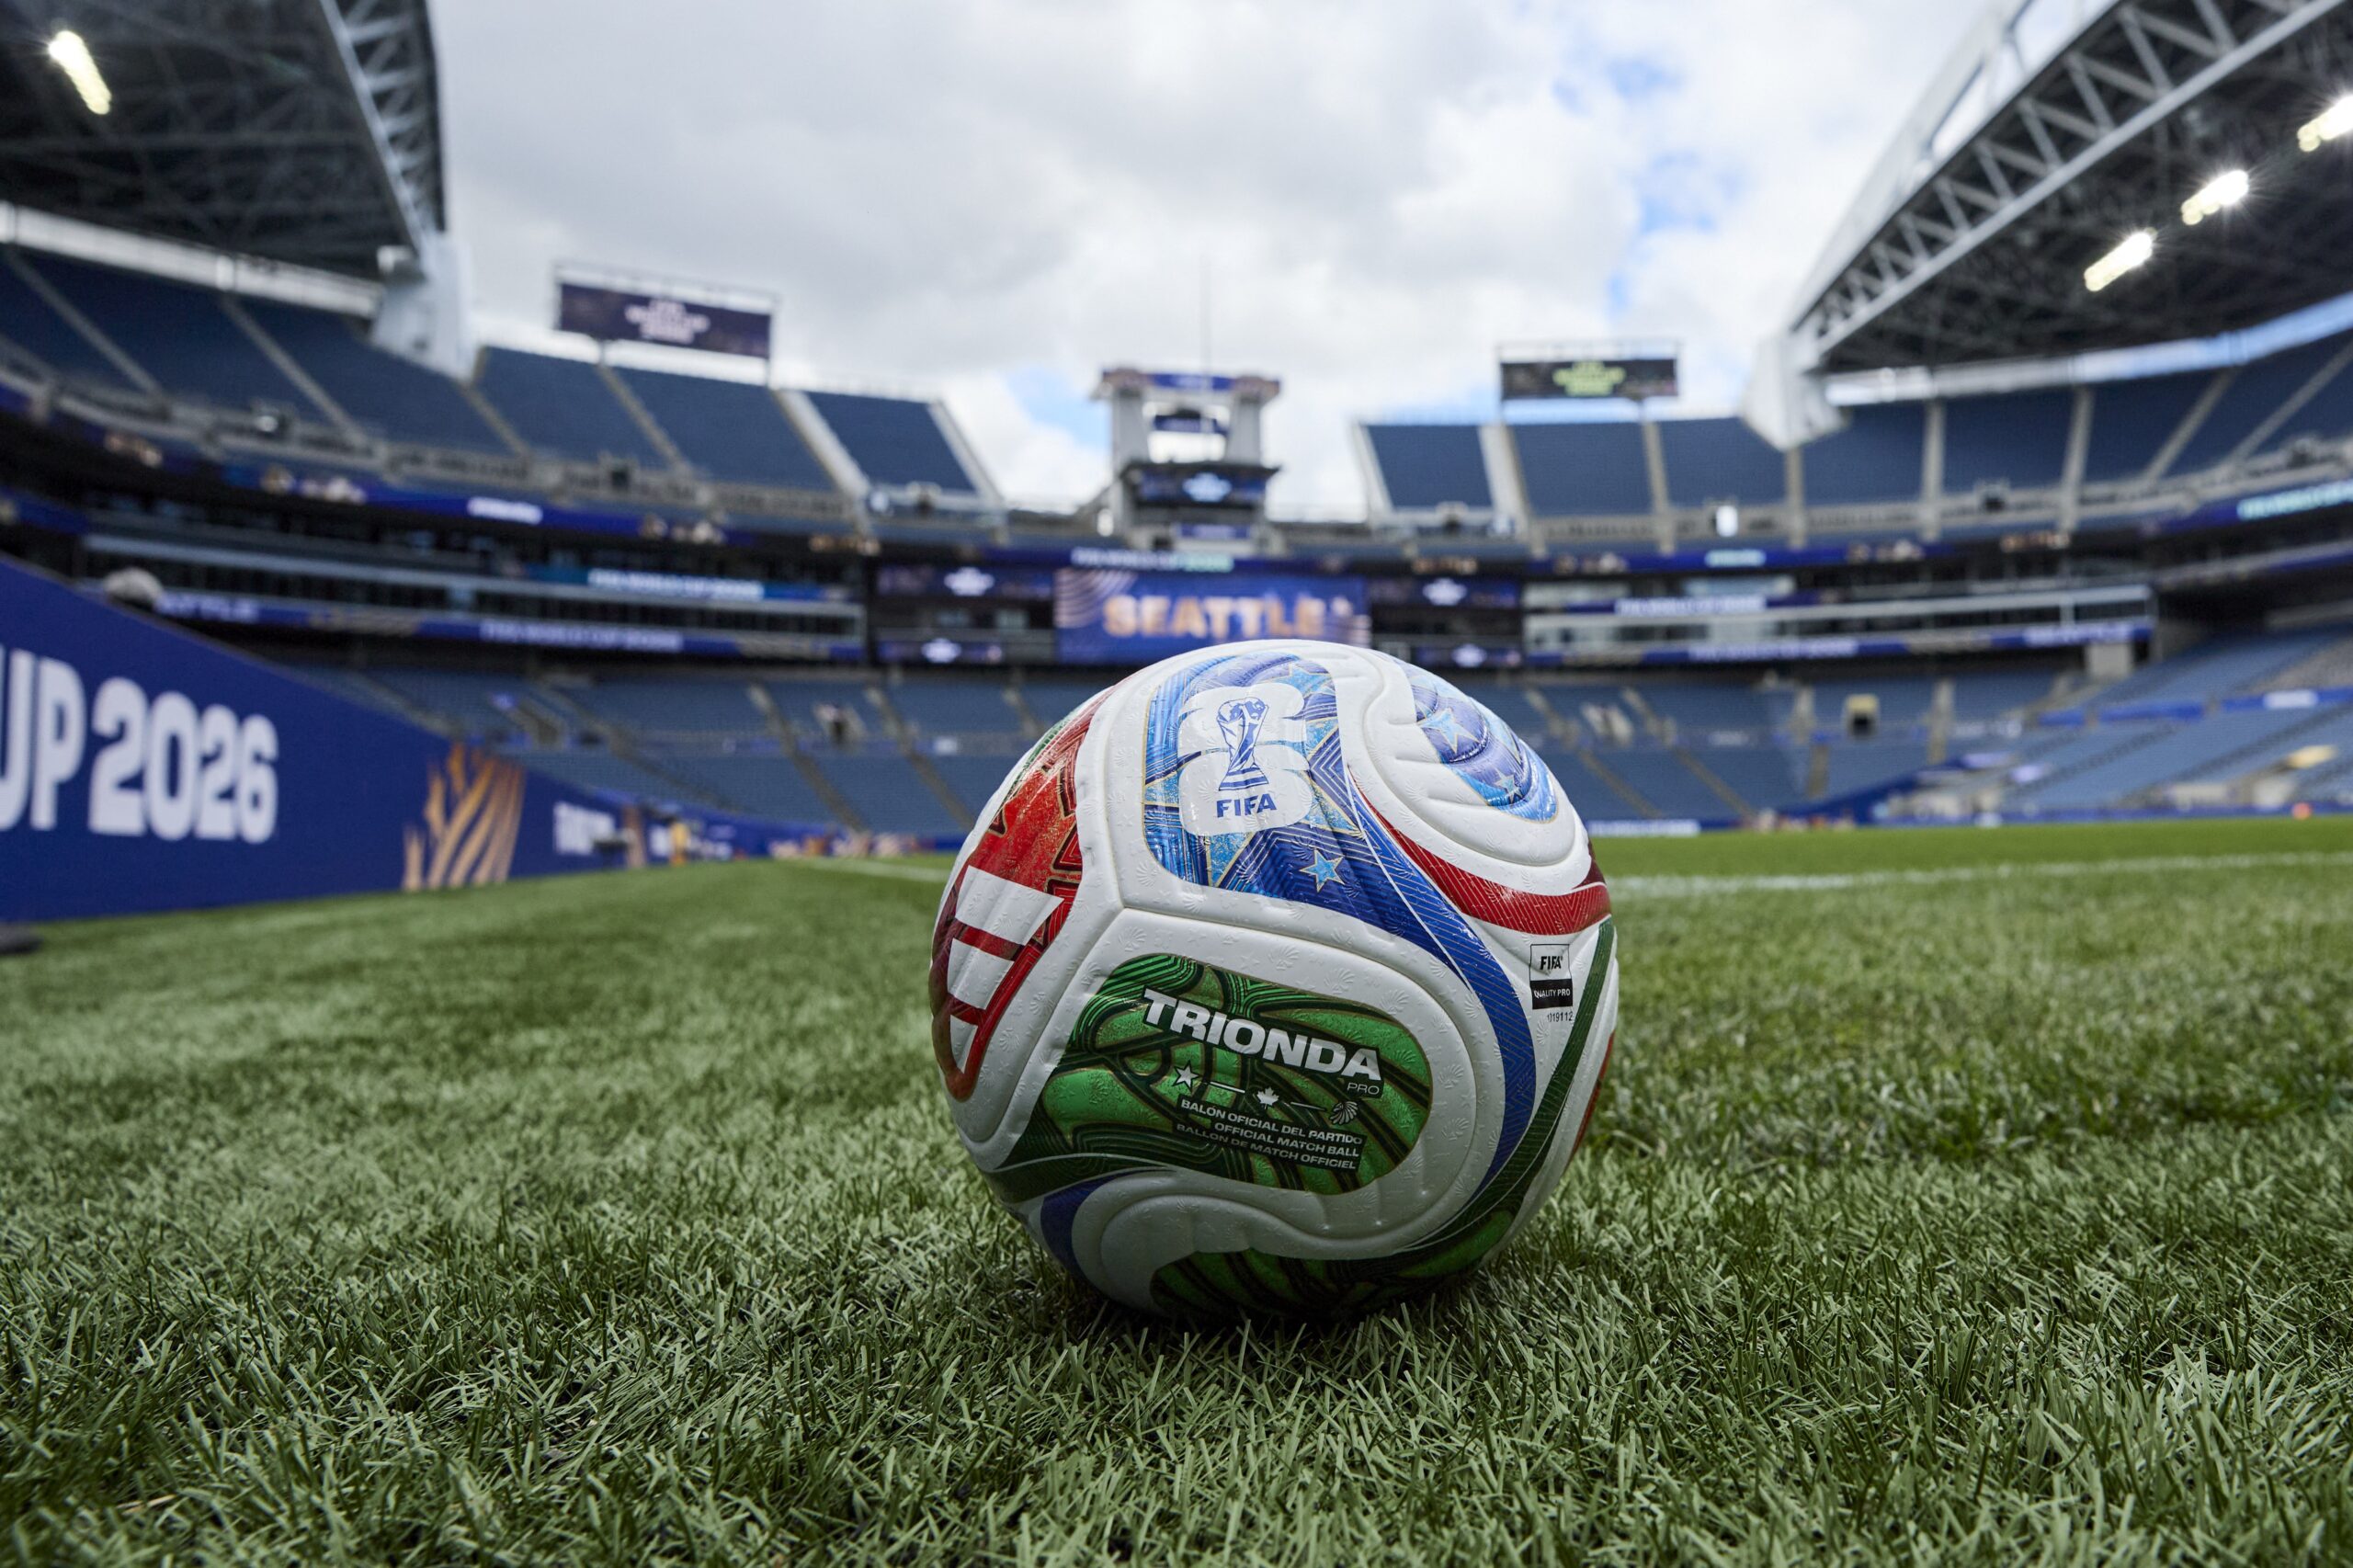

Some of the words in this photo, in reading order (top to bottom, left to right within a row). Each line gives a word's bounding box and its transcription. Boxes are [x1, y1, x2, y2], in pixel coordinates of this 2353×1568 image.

[1104, 595, 1326, 639] SEATTLE
[88, 676, 278, 845] 2026
[1216, 793, 1278, 818] FIFA
[1540, 955, 1562, 971] FIFA
[1533, 989, 1556, 999] QUALITY
[1557, 988, 1571, 996] PRO
[1142, 987, 1381, 1081] TRIONDA
[1347, 1082, 1380, 1095] PRO
[1181, 1098, 1226, 1119] BALÓN
[1227, 1113, 1279, 1132] OFICIAL
[1280, 1125, 1306, 1138] DEL
[1308, 1131, 1362, 1145] PARTIDO
[1214, 1122, 1274, 1143] OFFICIAL
[1277, 1137, 1325, 1153] MATCH
[1327, 1146, 1359, 1157] BALL
[1176, 1124, 1228, 1143] BALLON
[1231, 1138, 1249, 1147] DE
[1250, 1143, 1299, 1160] MATCH
[1300, 1154, 1357, 1169] OFFICIEL
